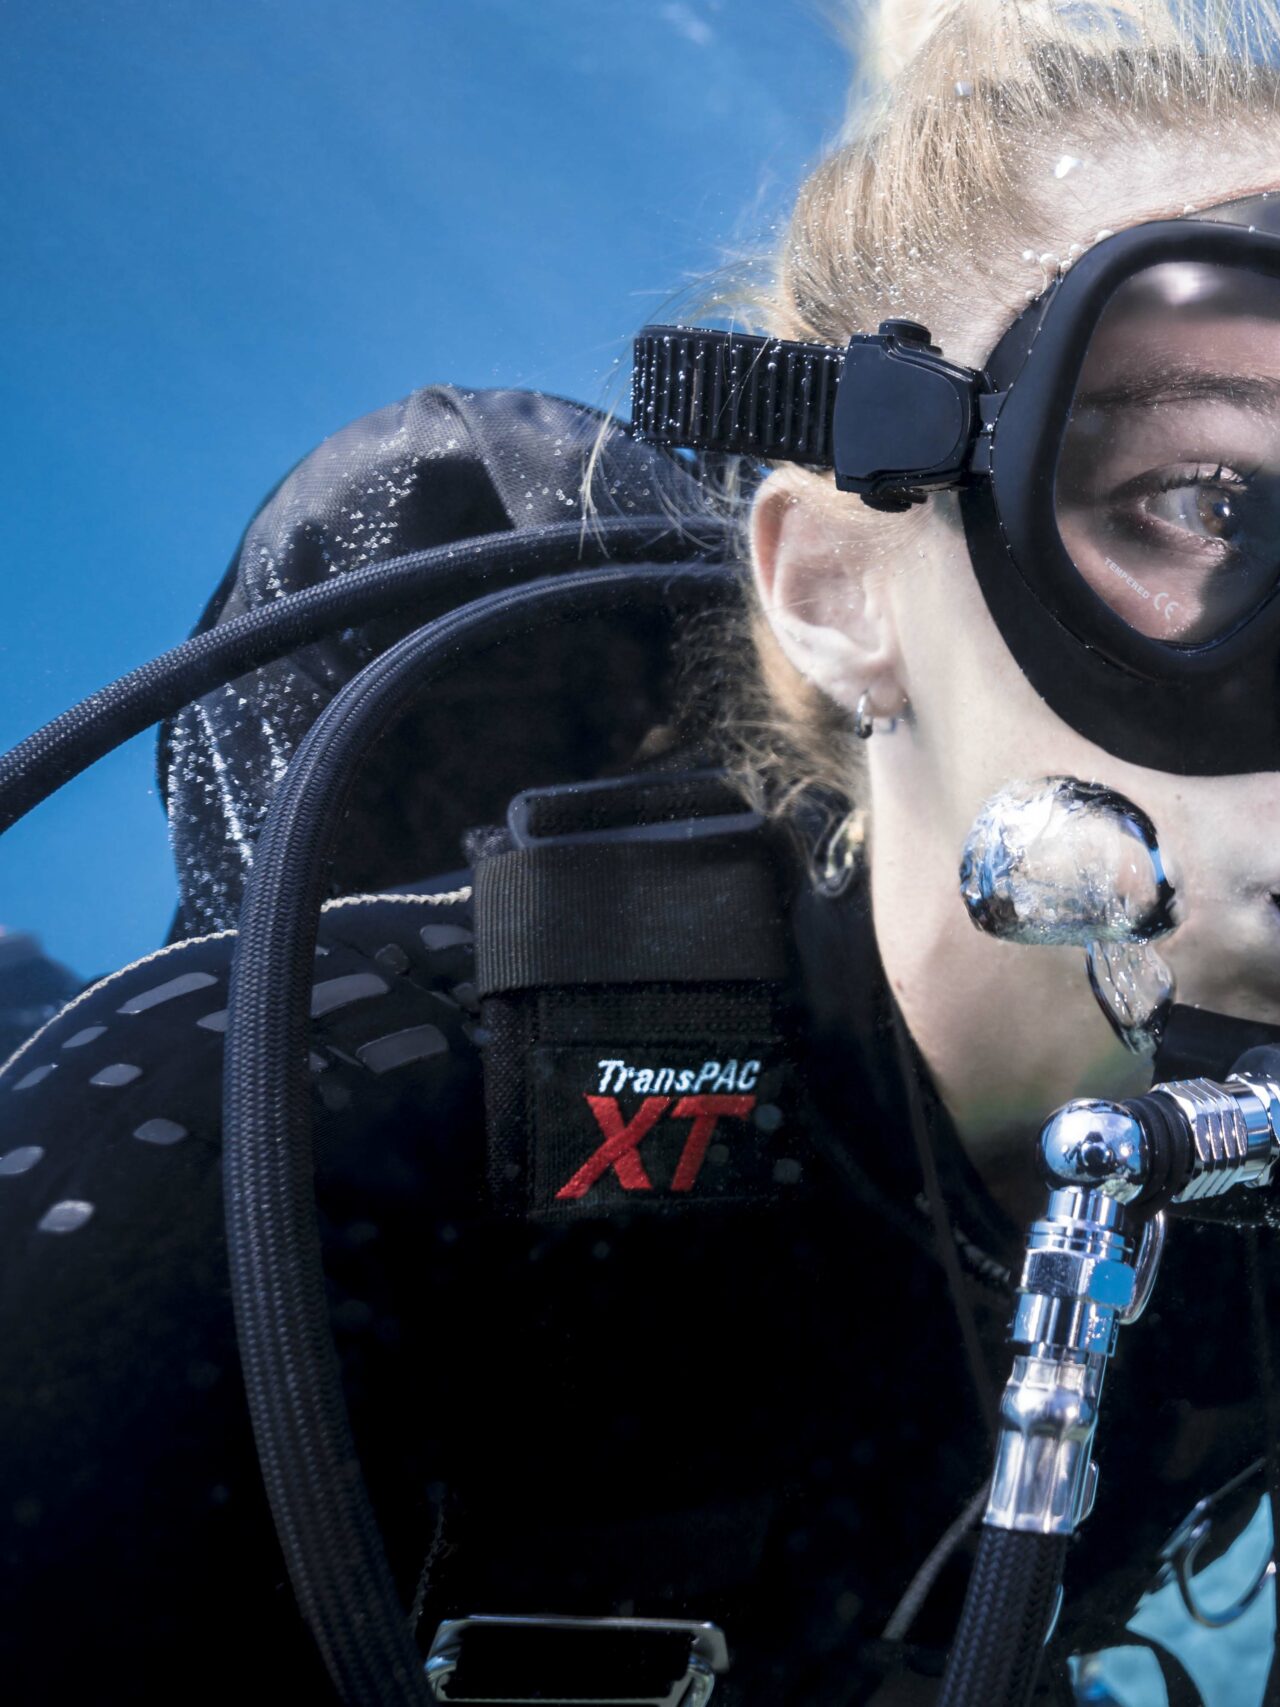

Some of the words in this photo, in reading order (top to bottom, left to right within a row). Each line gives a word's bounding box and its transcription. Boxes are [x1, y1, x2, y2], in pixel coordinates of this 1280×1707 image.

[1104, 558, 1150, 600] TEMPERED
[597, 1060, 761, 1093] TransPAC
[555, 1094, 755, 1199] XT
